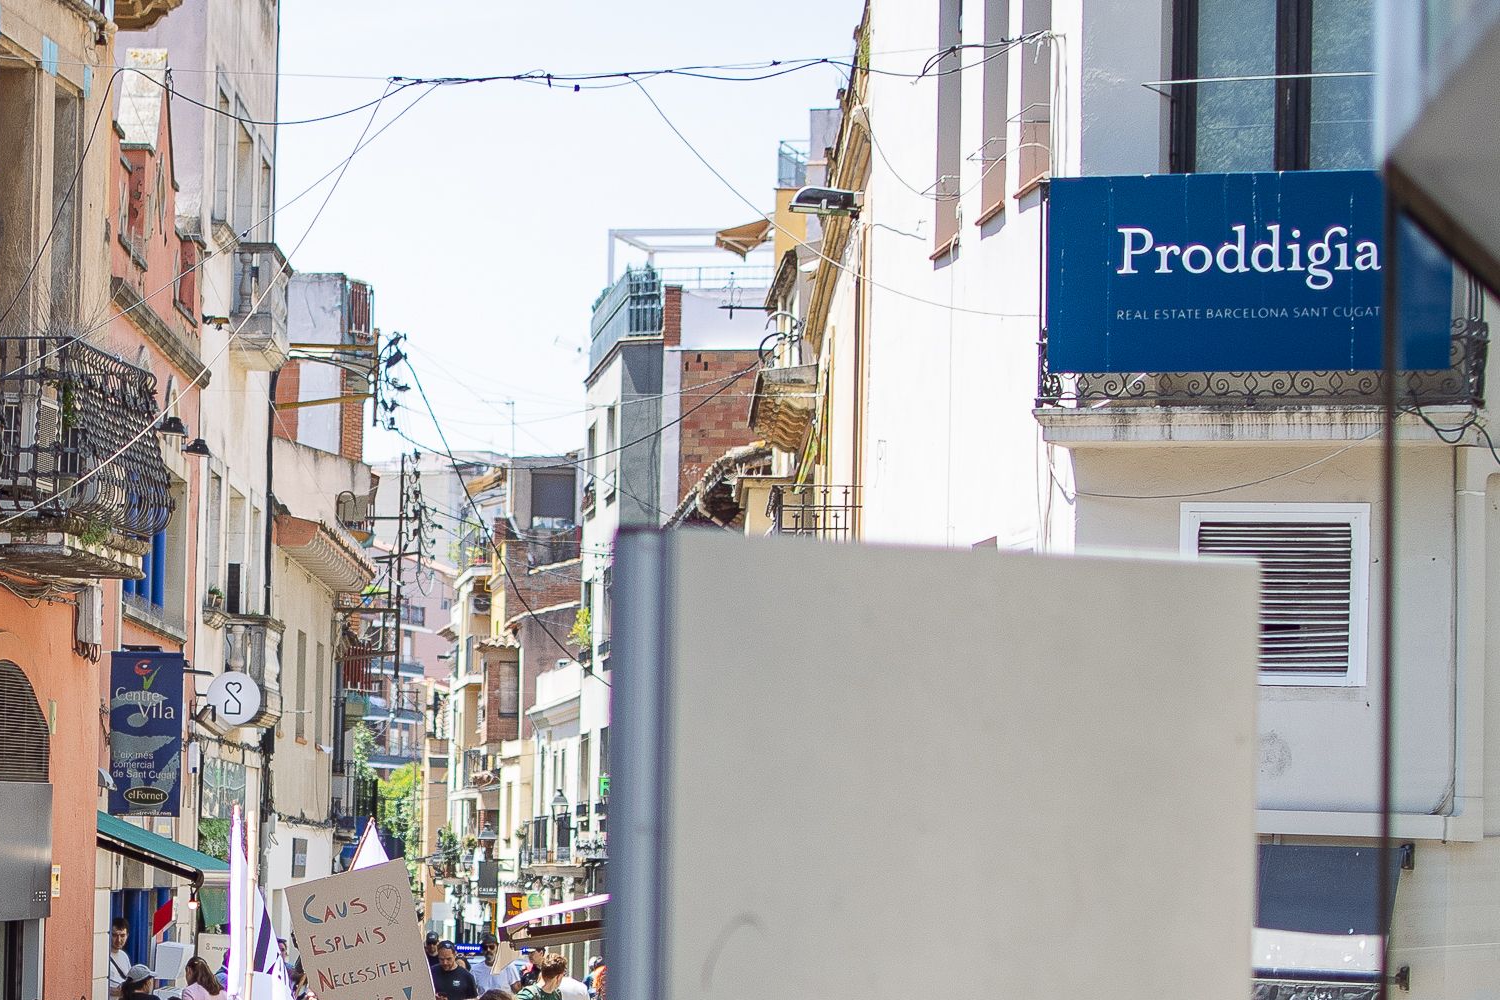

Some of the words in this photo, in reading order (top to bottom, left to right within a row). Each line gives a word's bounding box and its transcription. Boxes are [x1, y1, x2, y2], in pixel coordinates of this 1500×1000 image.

[1116, 224, 1381, 290] Proddigia
[1116, 309, 1149, 321] REAL
[1153, 308, 1202, 320] ESTATE
[1206, 307, 1288, 319] BARCELONA
[1292, 306, 1328, 318] SANT
[1332, 306, 1381, 318] CUGAT
[115, 686, 160, 701] Centre
[137, 700, 175, 719] Vila
[113, 760, 155, 769] comercial
[112, 770, 125, 778] de
[126, 769, 147, 779] Sant
[148, 770, 177, 781] Cugat
[302, 894, 368, 924] CAUS
